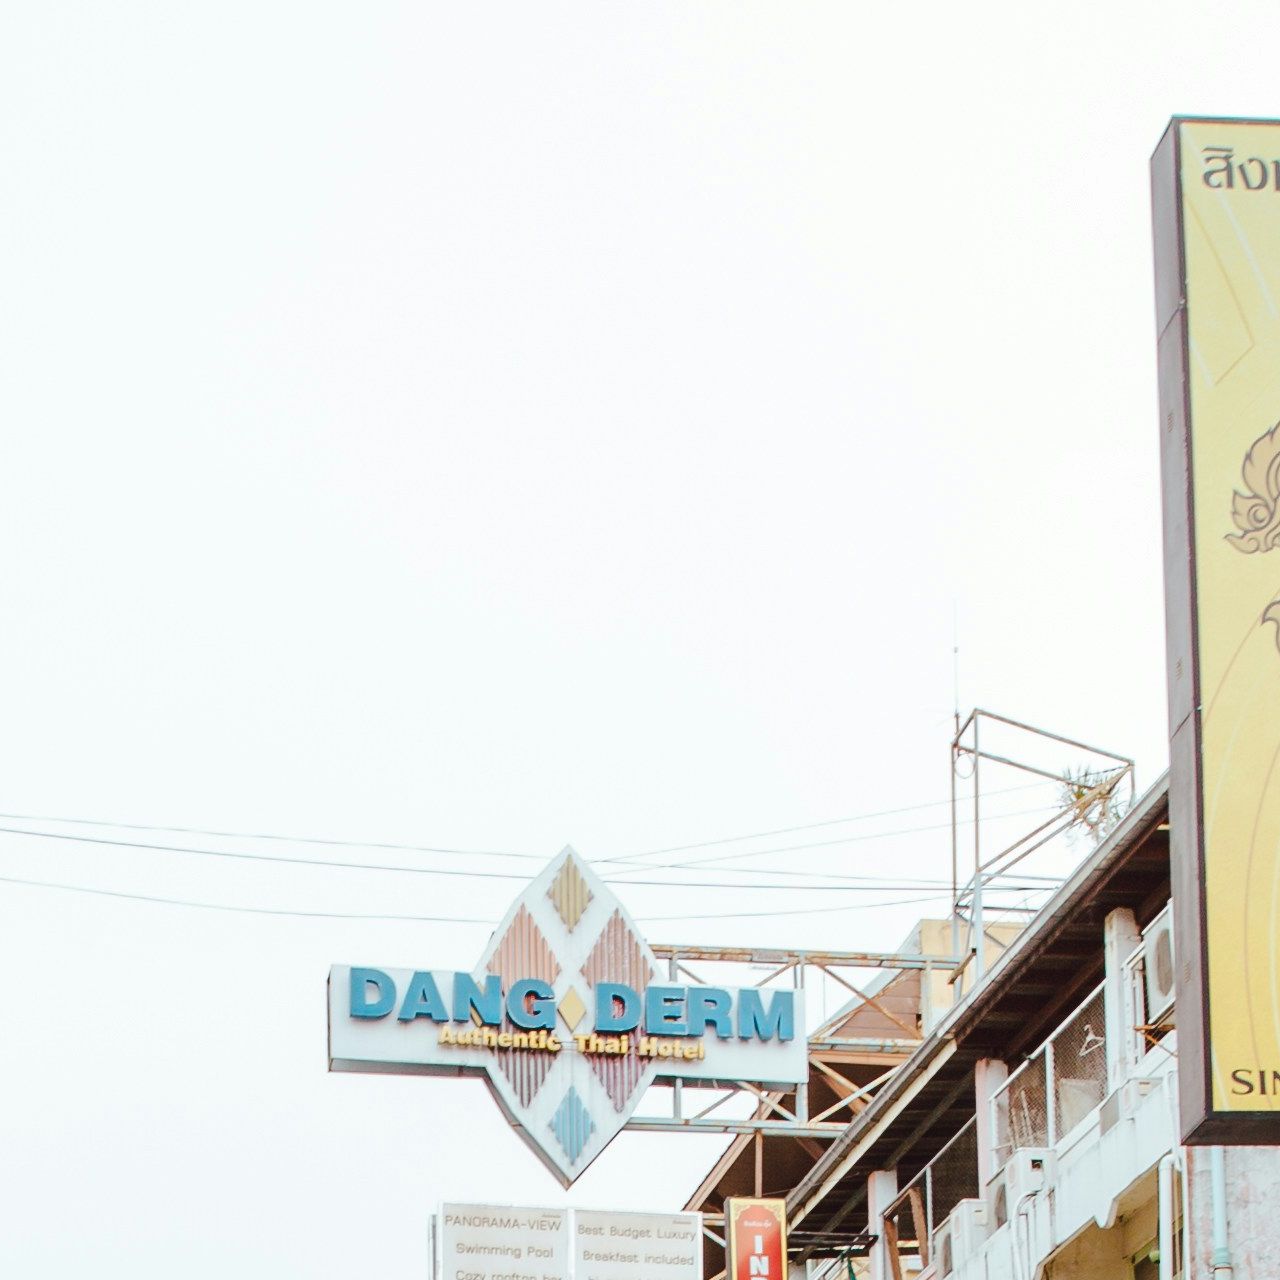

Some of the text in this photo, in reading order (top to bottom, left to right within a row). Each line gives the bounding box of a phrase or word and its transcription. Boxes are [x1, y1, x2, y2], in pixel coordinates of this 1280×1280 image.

[350, 966, 795, 1042] DANG DERM
[438, 1025, 705, 1060] Authentic Thai Hotel
[445, 1214, 562, 1231] PANORAMA-VIEW
[578, 1224, 697, 1242] Best Budget Luxury
[456, 1243, 554, 1259] Swimming Pool
[583, 1250, 694, 1265] Breakfast included
